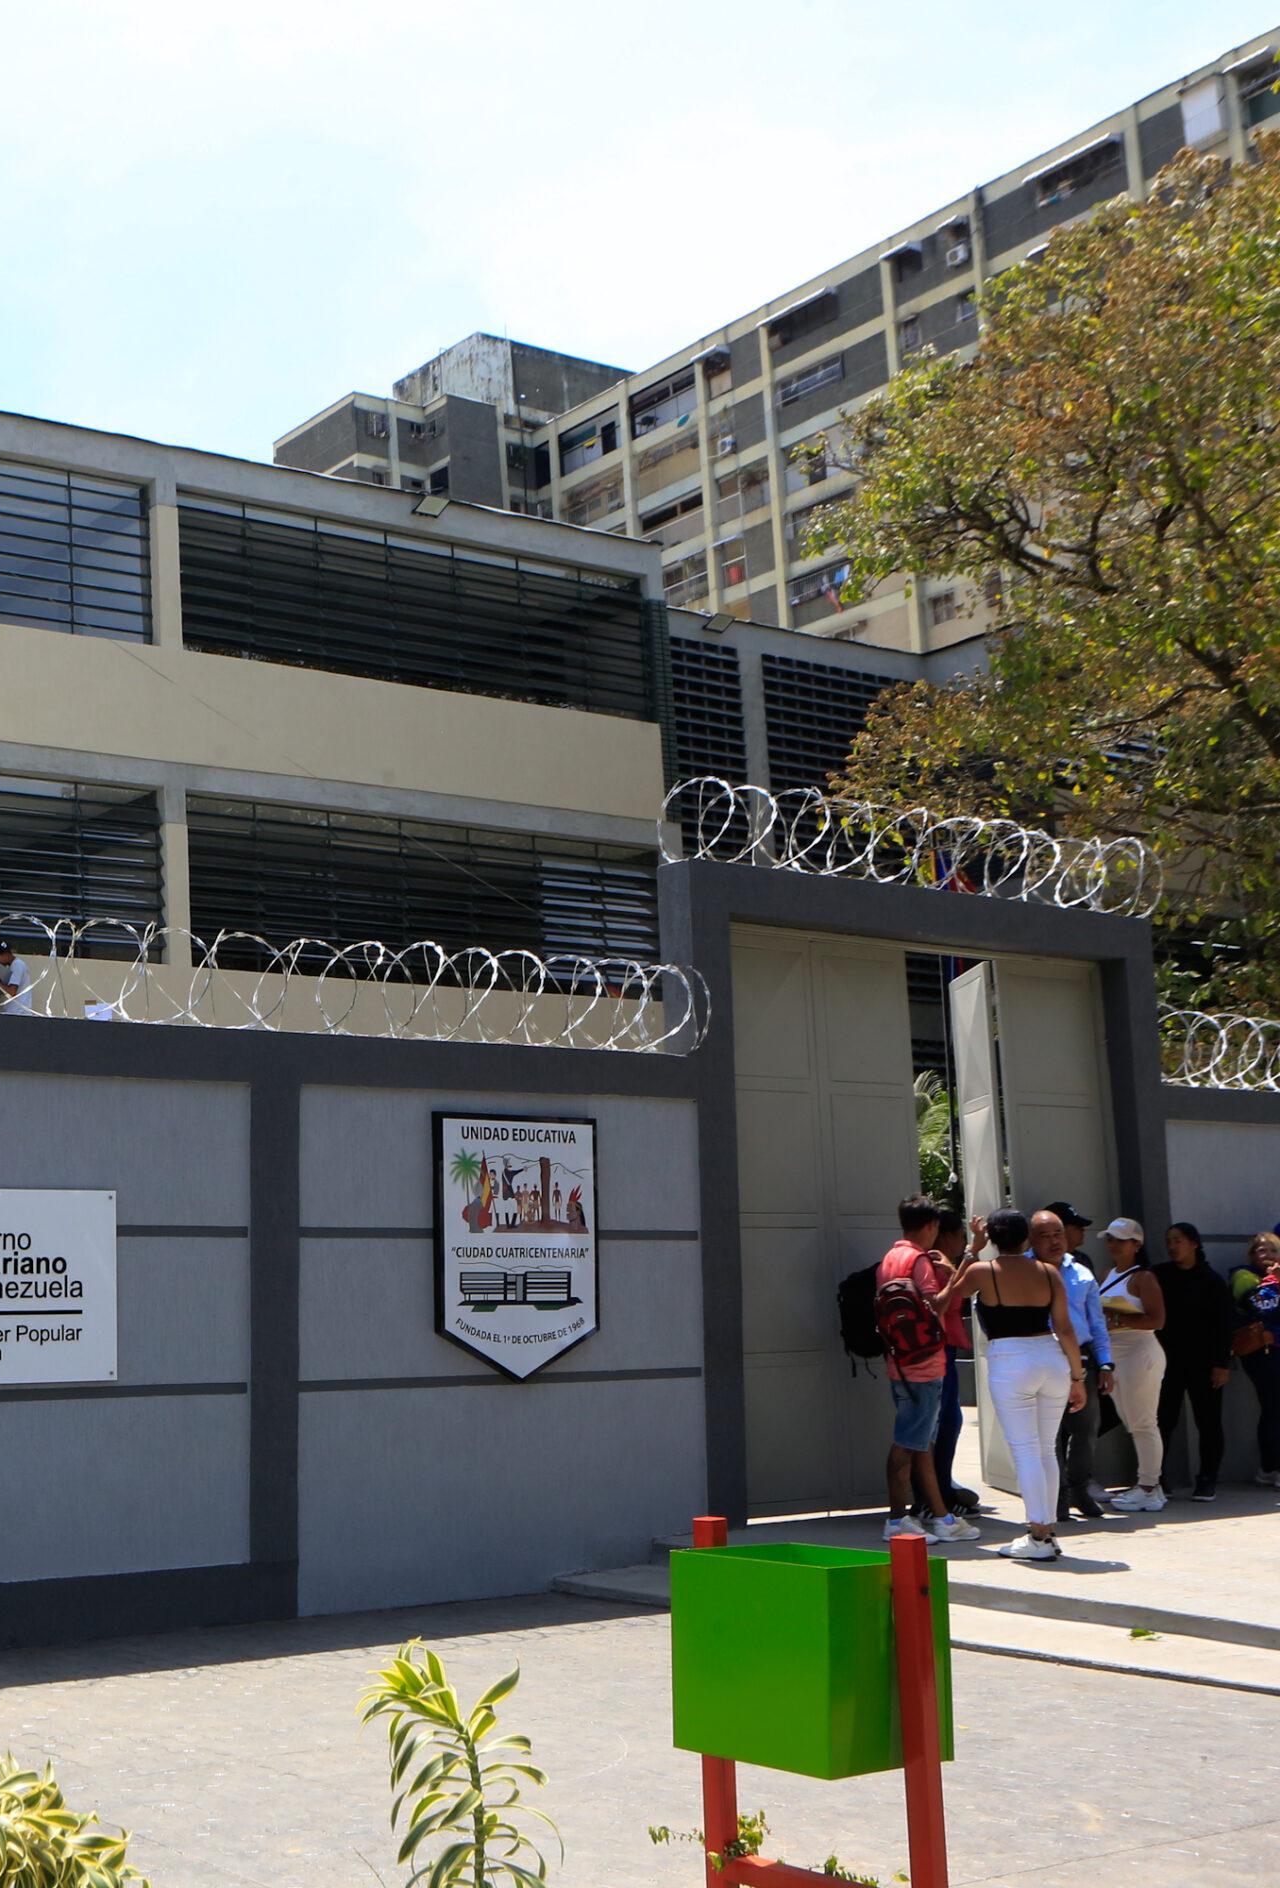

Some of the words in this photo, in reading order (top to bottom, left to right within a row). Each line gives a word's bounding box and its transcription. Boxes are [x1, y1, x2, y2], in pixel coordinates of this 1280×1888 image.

[461, 1125, 509, 1141] UNIDAD
[512, 1127, 577, 1144] EDUCATIVA
[451, 1246, 494, 1259] "CIUDAD
[495, 1247, 589, 1260] CUATRICENTENARIA"
[16, 1325, 83, 1346] Popular
[455, 1317, 492, 1341] FUNDADA
[493, 1335, 502, 1344] EL
[512, 1335, 522, 1345] DE
[523, 1330, 557, 1345] OCTUBRE
[558, 1328, 568, 1338] DE
